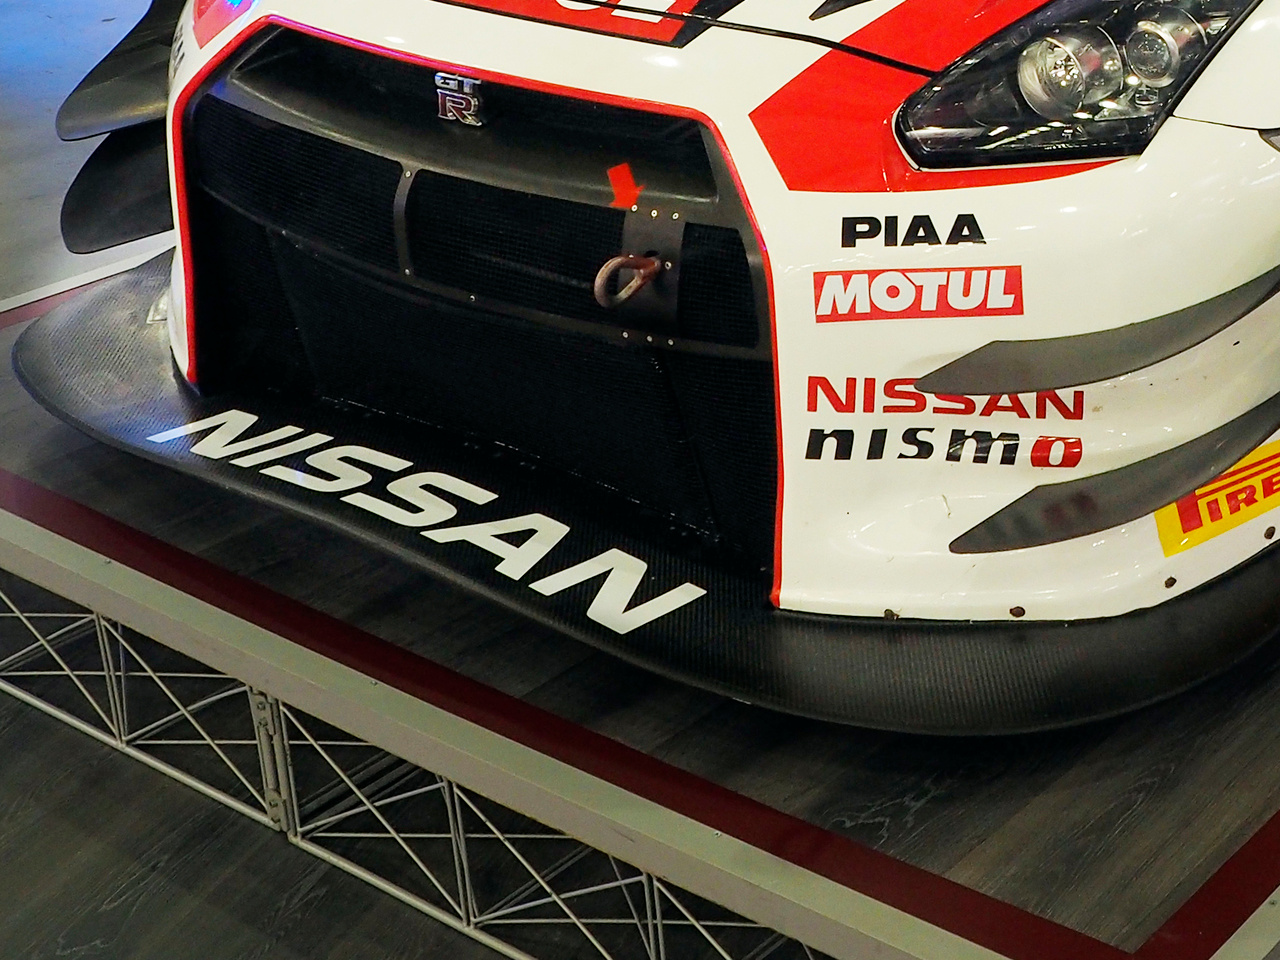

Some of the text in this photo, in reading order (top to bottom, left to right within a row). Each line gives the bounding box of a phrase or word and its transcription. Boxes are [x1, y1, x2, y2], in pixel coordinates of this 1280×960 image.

[841, 213, 987, 248] PIAA
[815, 269, 1016, 316] MOTUL
[806, 375, 1085, 421] NISSAN
[804, 427, 1083, 469] nismo
[148, 408, 708, 635] NISSAN
